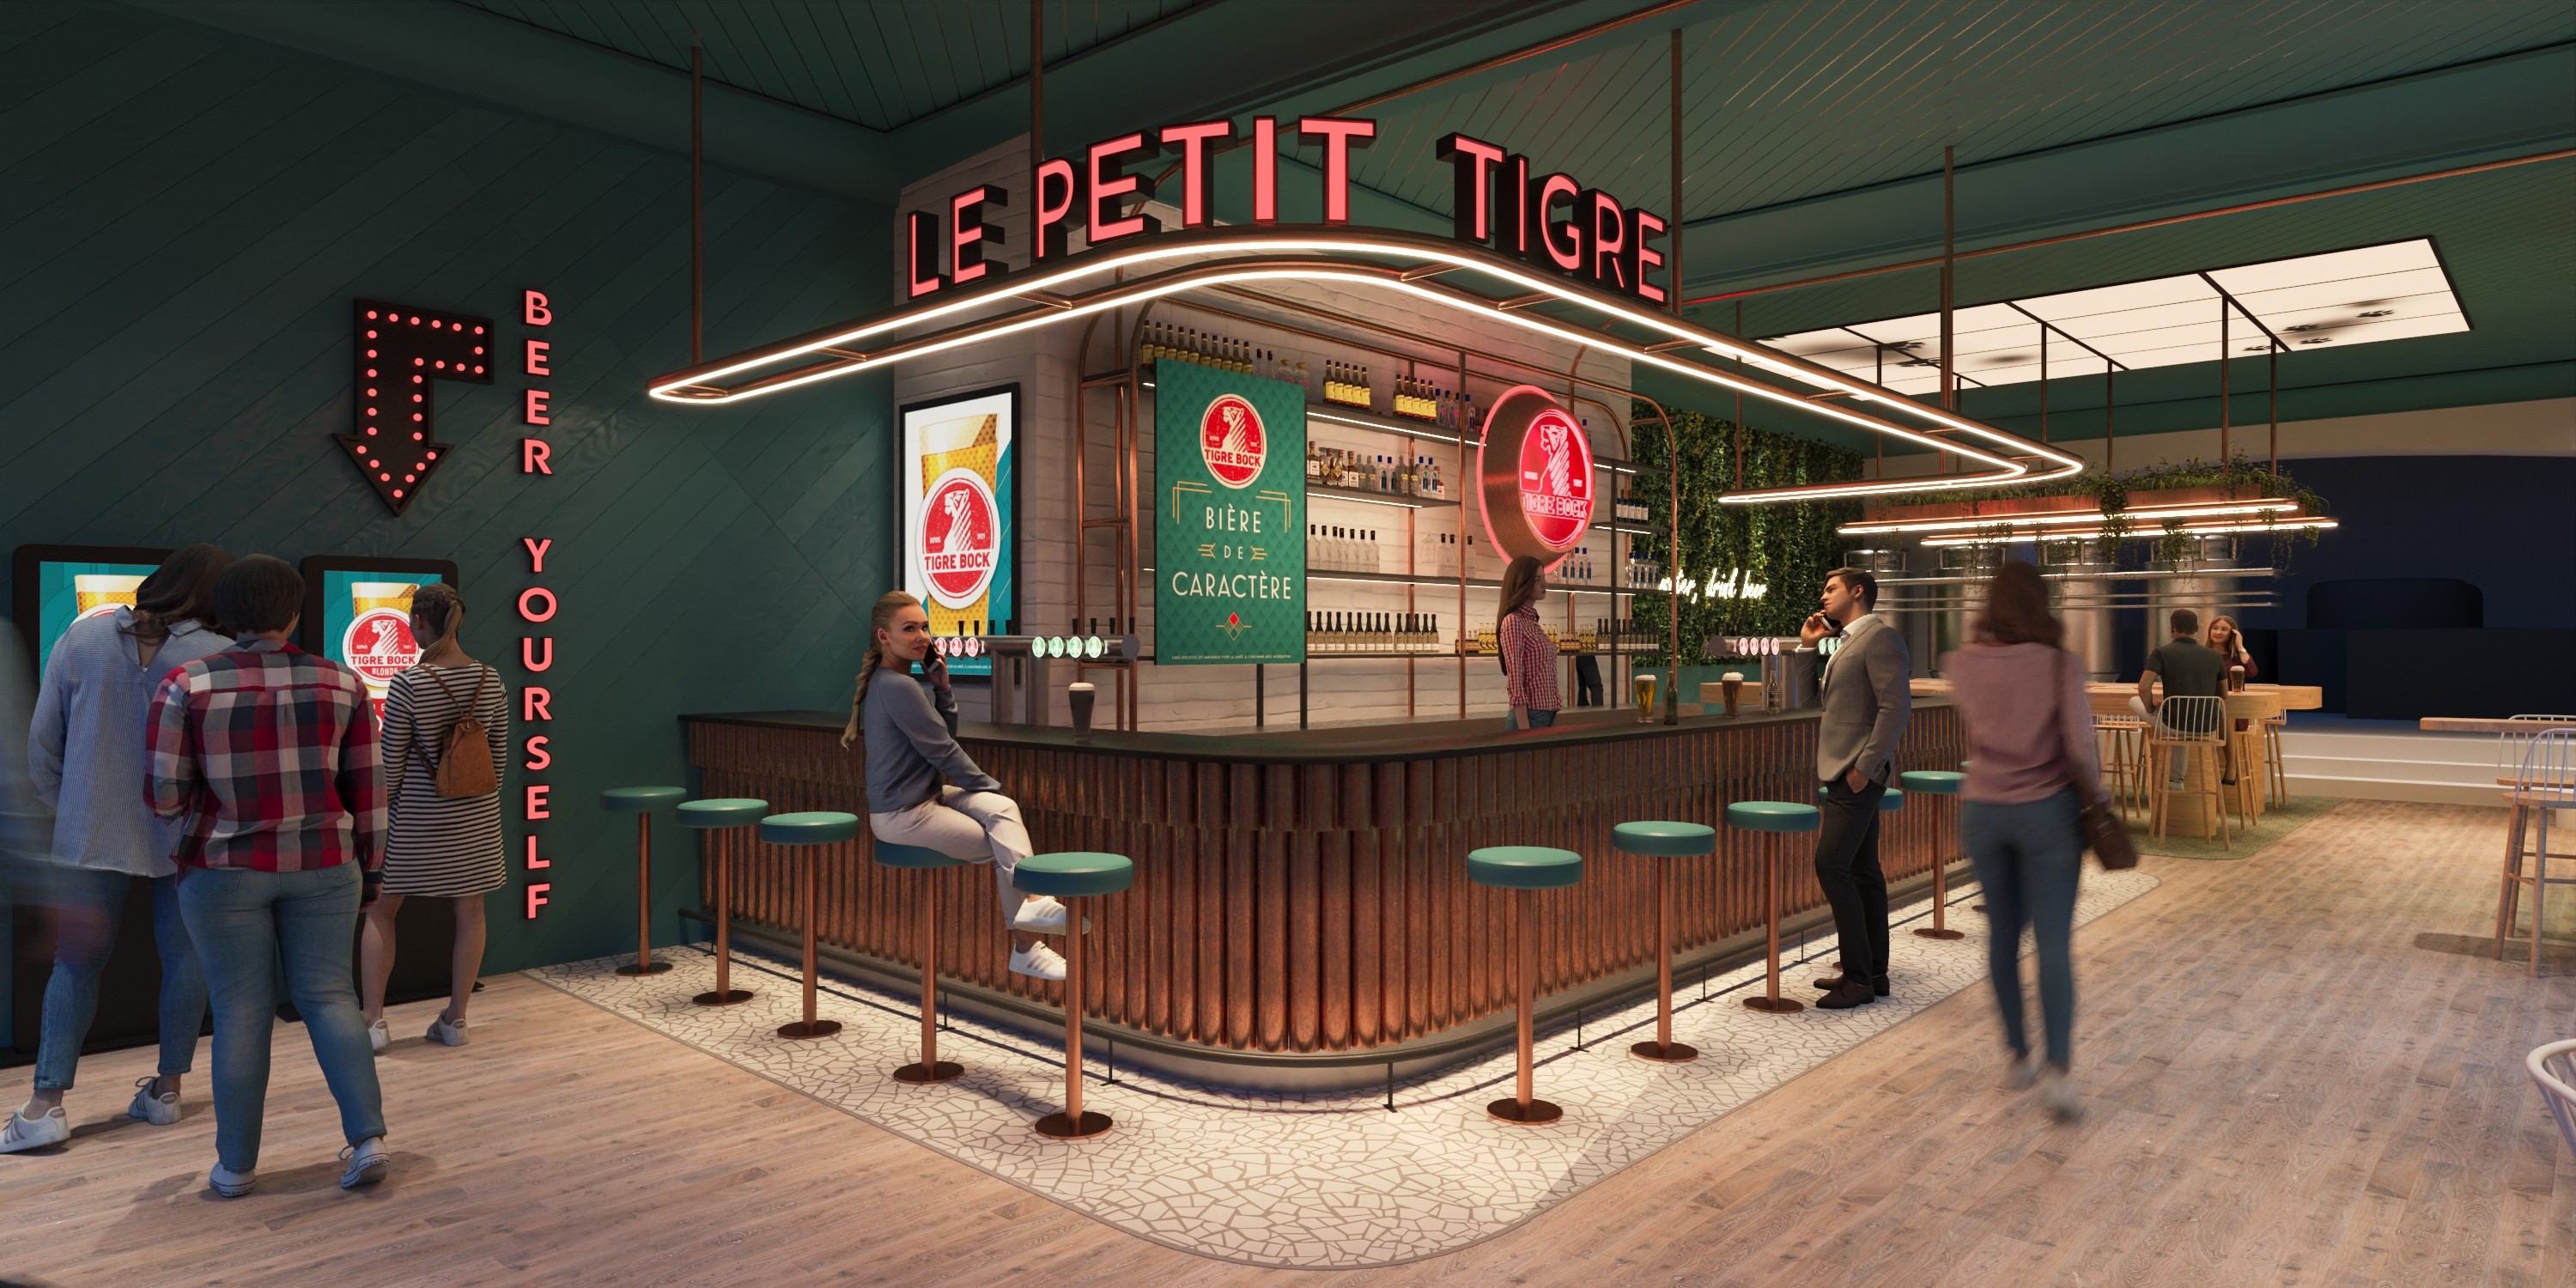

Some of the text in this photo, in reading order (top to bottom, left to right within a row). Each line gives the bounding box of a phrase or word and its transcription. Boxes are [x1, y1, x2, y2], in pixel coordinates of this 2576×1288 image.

[908, 115, 1667, 303] LE PETIT TIGRE
[1205, 449, 1261, 467] TIGRE BOCK
[1206, 503, 1261, 533] BIÈRE
[1522, 491, 1589, 518] TIGRE BOCK
[924, 552, 991, 570] TIGRE BOCK
[1224, 545, 1243, 559] DE
[1172, 569, 1291, 599] CARACTÈRE
[517, 289, 558, 920] BEER YOURSELF
[350, 655, 416, 665] TIGRE BOCK
